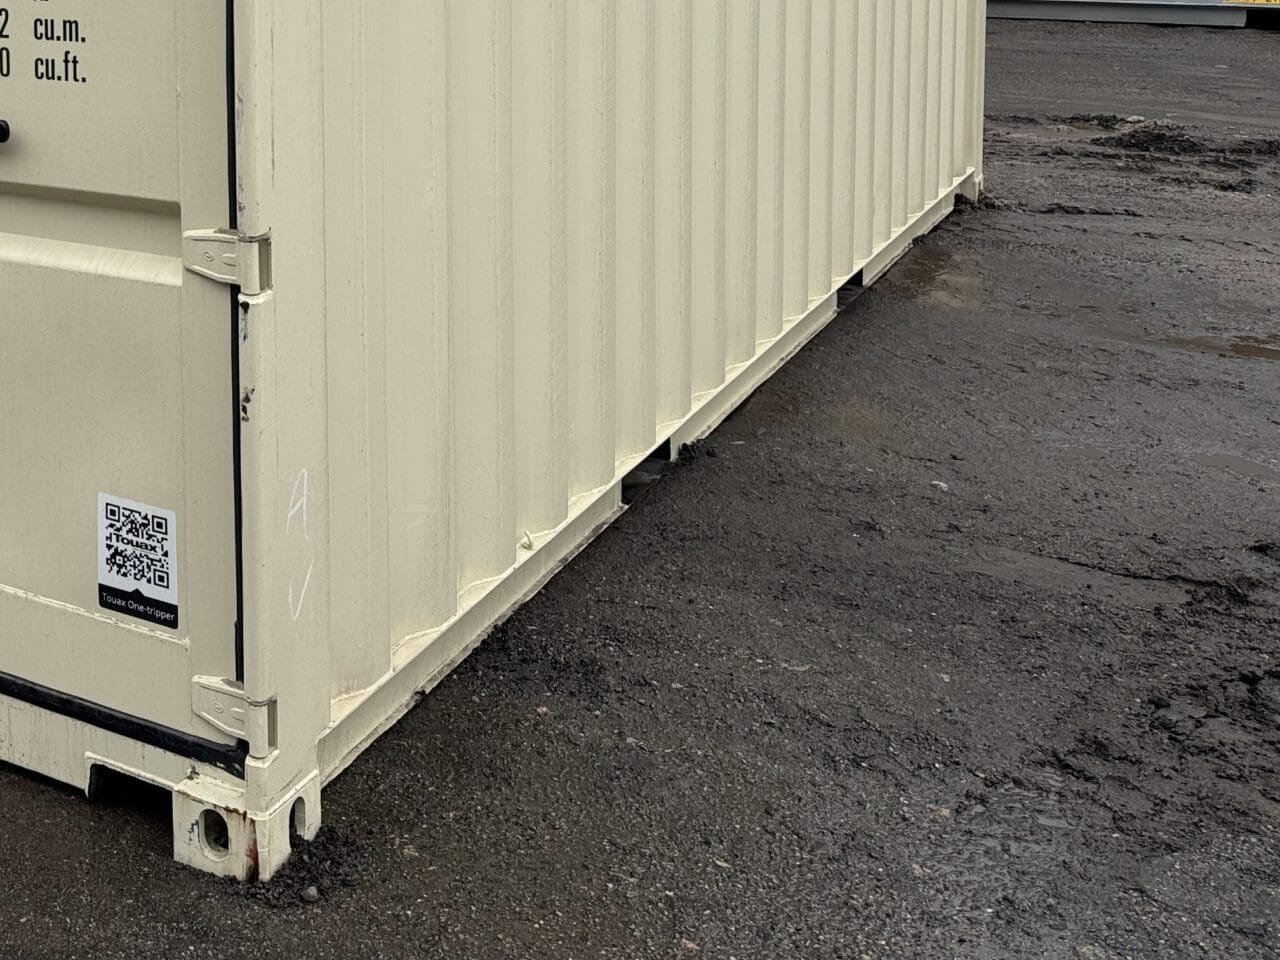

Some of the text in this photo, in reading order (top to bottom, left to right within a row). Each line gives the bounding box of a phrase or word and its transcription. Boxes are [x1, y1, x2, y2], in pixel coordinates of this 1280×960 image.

[33, 18, 87, 43] cu.m.
[34, 50, 87, 83] cu.ft.
[113, 532, 158, 554] Touax
[102, 592, 176, 621] Touax One-tripper
